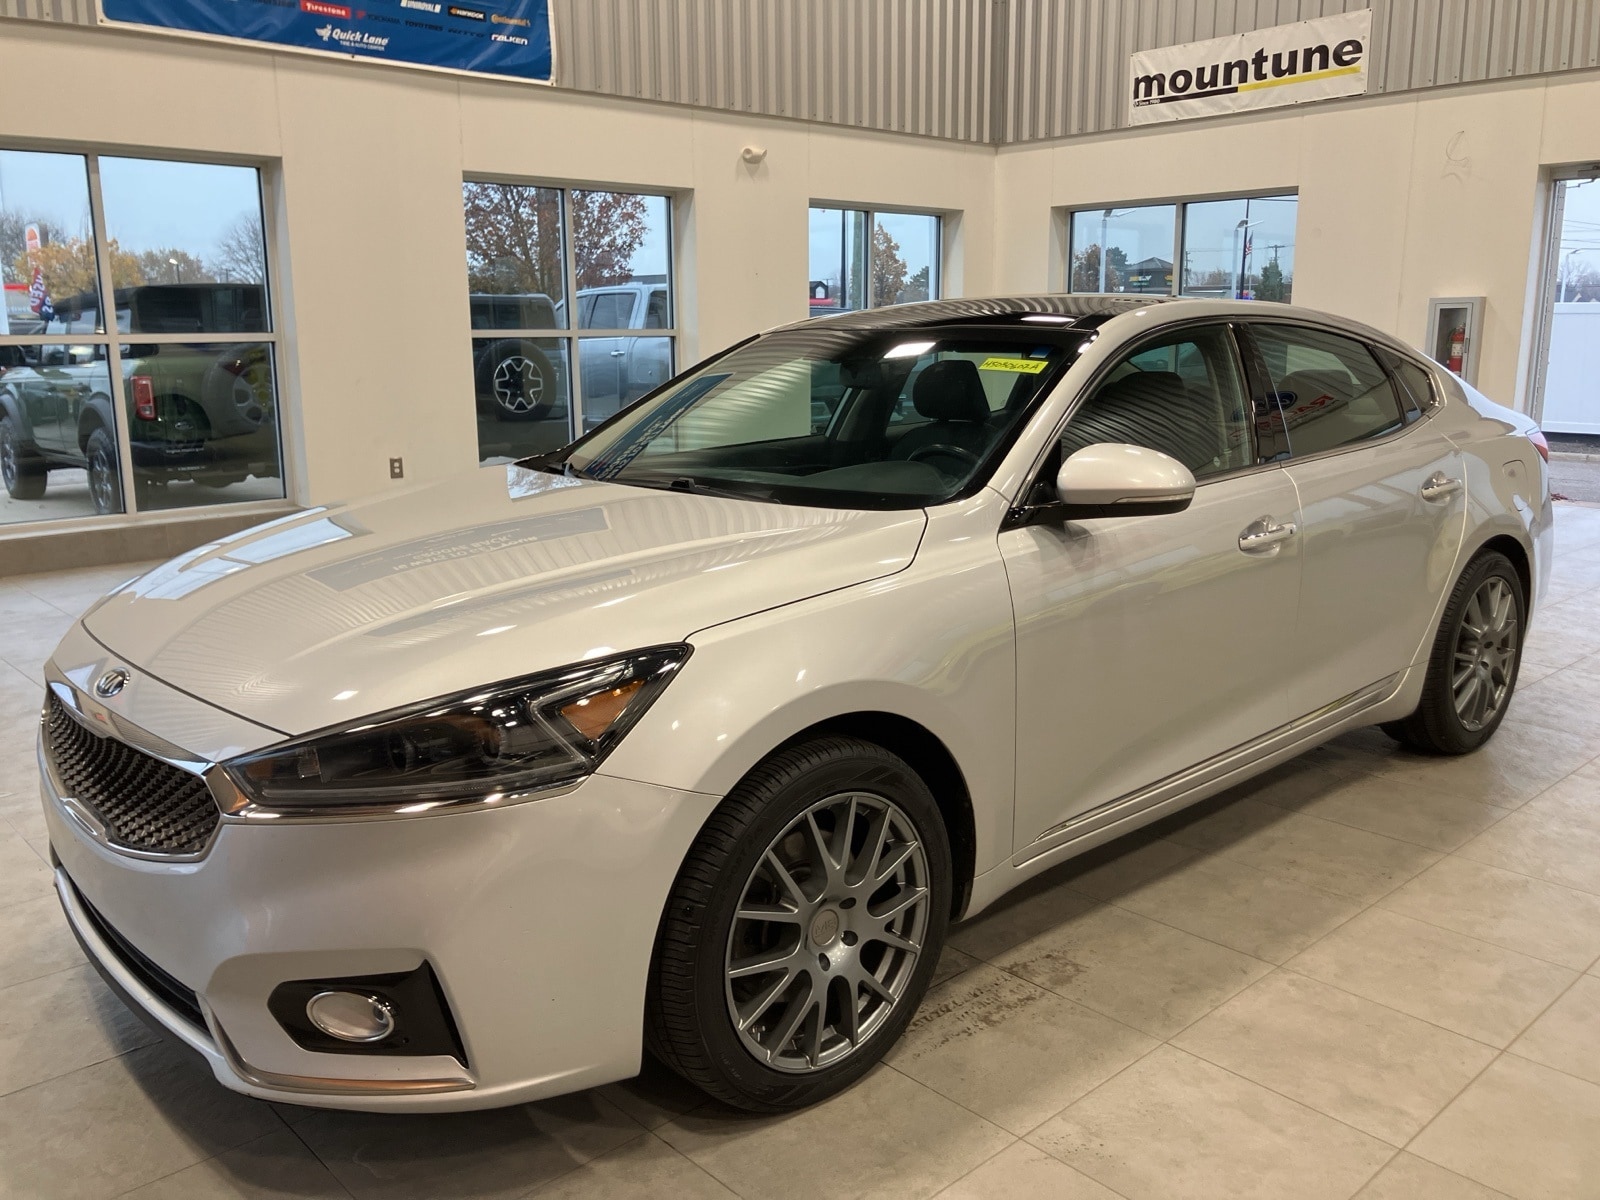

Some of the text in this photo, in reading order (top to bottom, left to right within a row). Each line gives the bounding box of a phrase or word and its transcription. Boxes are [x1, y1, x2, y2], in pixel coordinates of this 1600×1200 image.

[306, 2, 346, 16] Firestone
[332, 28, 389, 46] Quick Lane
[1133, 39, 1363, 100] mountune
